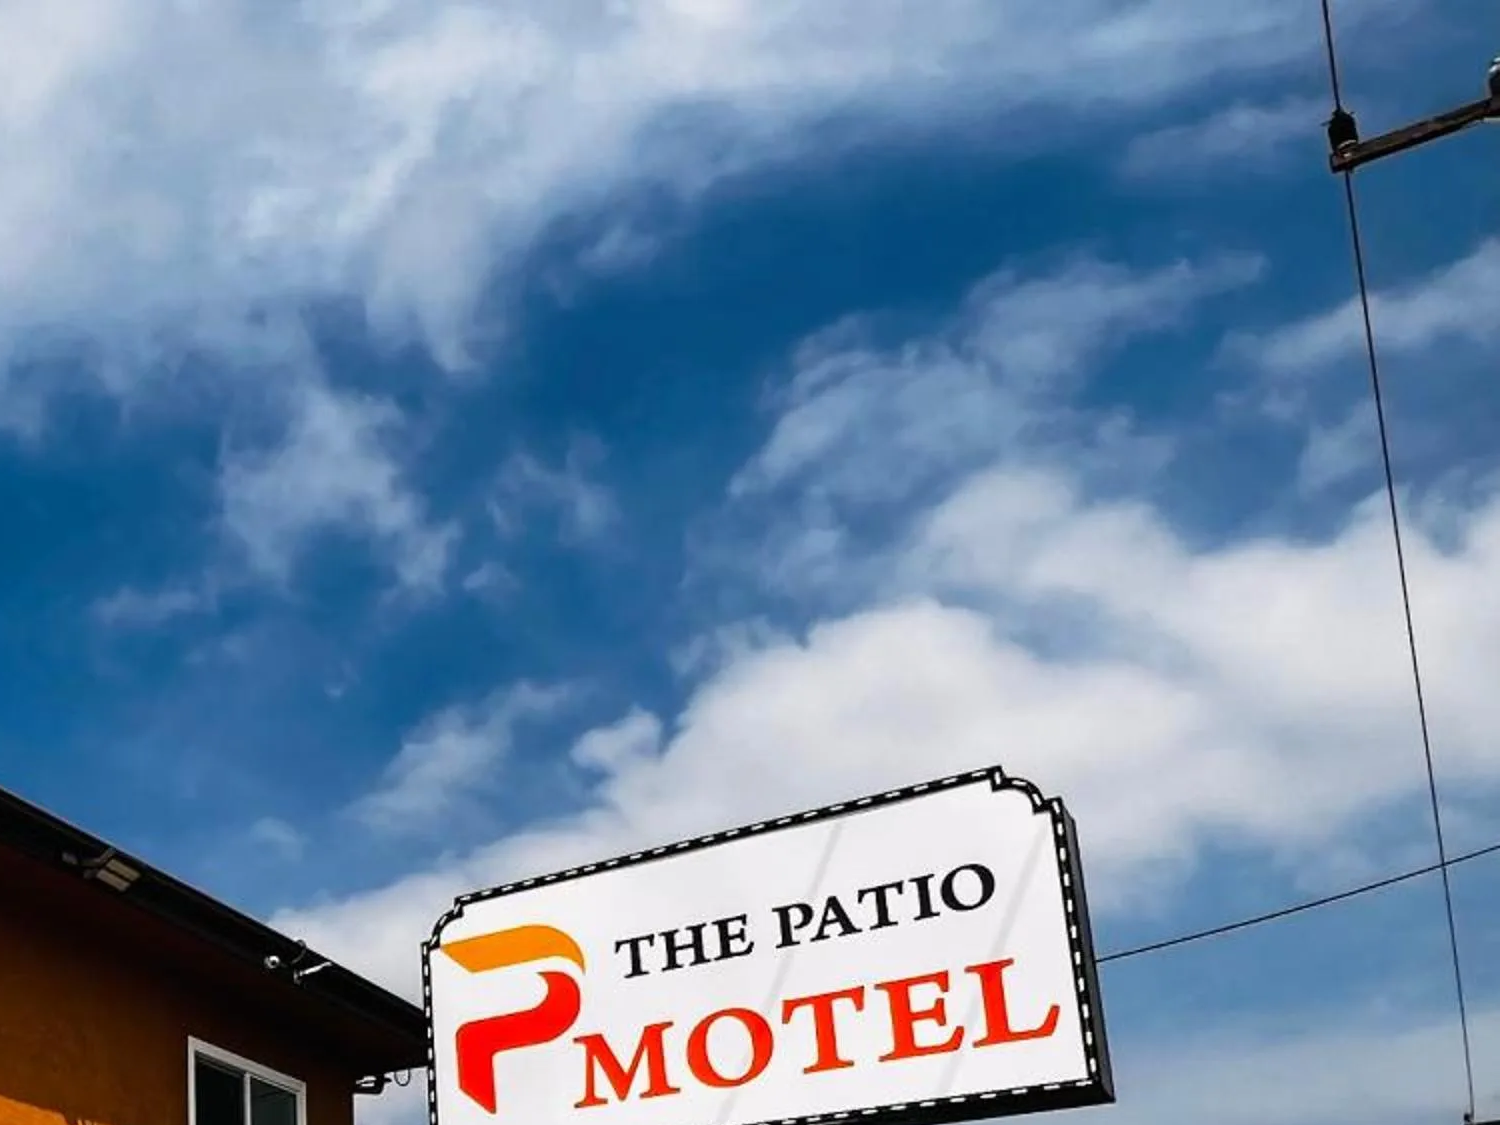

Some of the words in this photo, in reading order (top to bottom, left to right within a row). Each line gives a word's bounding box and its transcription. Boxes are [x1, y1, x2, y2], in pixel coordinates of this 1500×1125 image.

[614, 914, 755, 979] THE
[772, 863, 996, 949] PATIO
[574, 958, 1062, 1109] MOTEL
